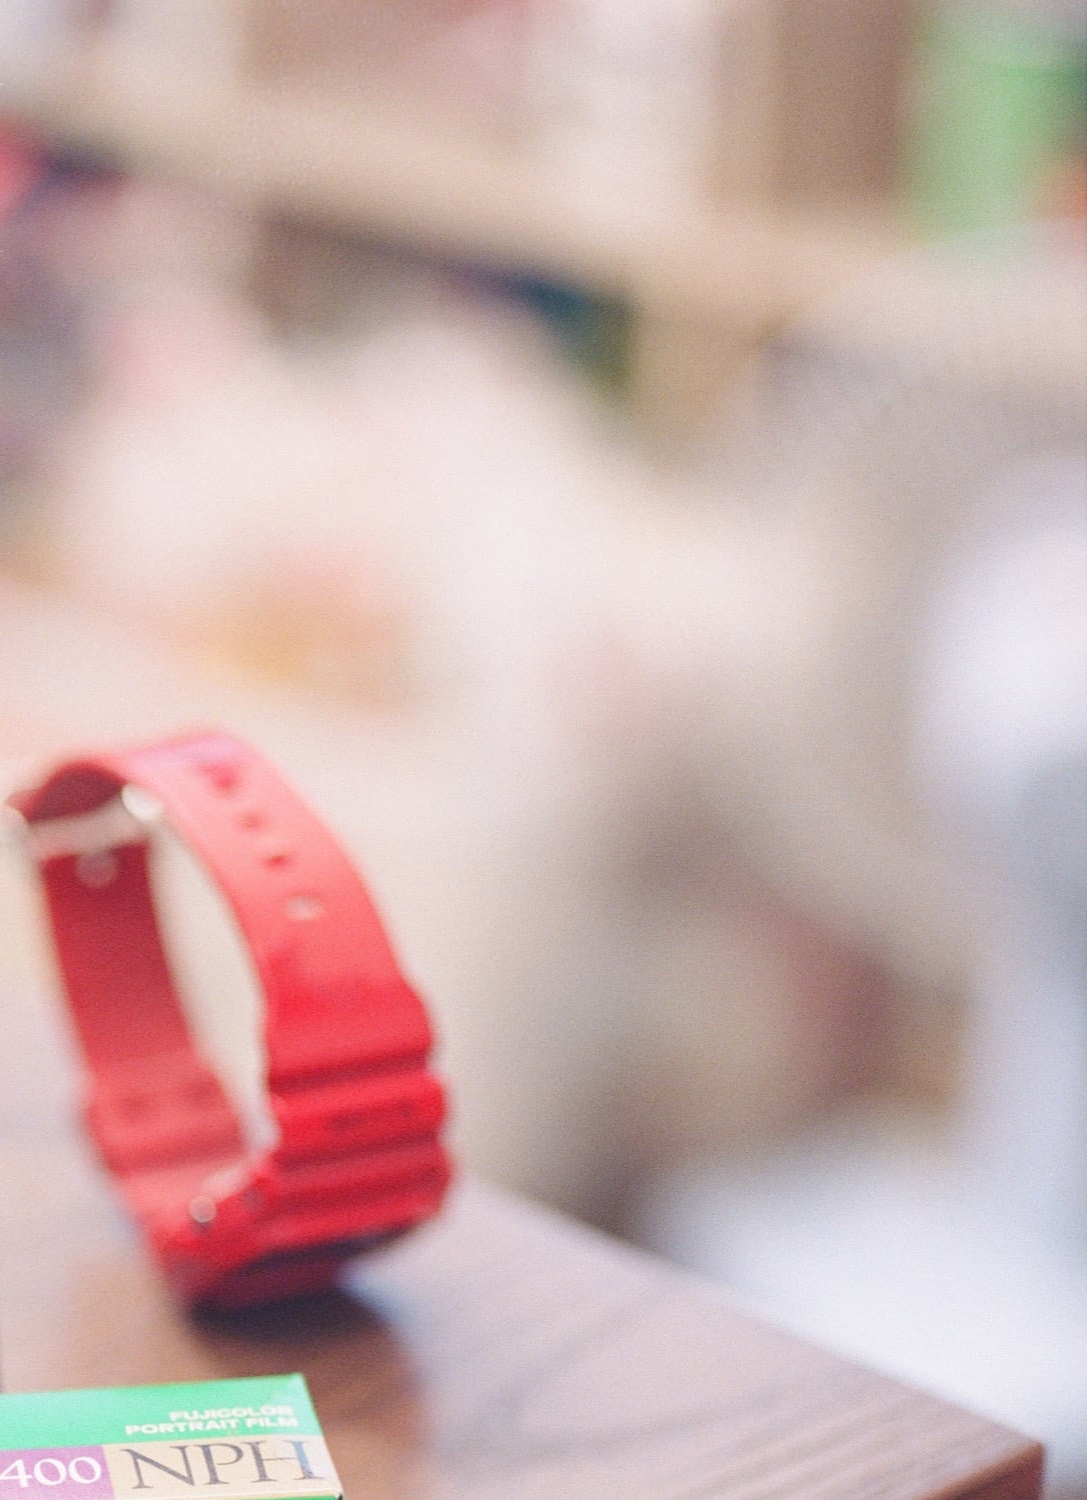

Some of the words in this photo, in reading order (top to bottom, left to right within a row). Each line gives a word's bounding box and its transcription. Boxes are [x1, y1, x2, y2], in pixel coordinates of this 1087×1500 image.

[169, 1405, 293, 1422] FUJICOLOR
[125, 1420, 239, 1436] PORTRAIT
[246, 1415, 299, 1429] FILM
[121, 1440, 326, 1489] NPH
